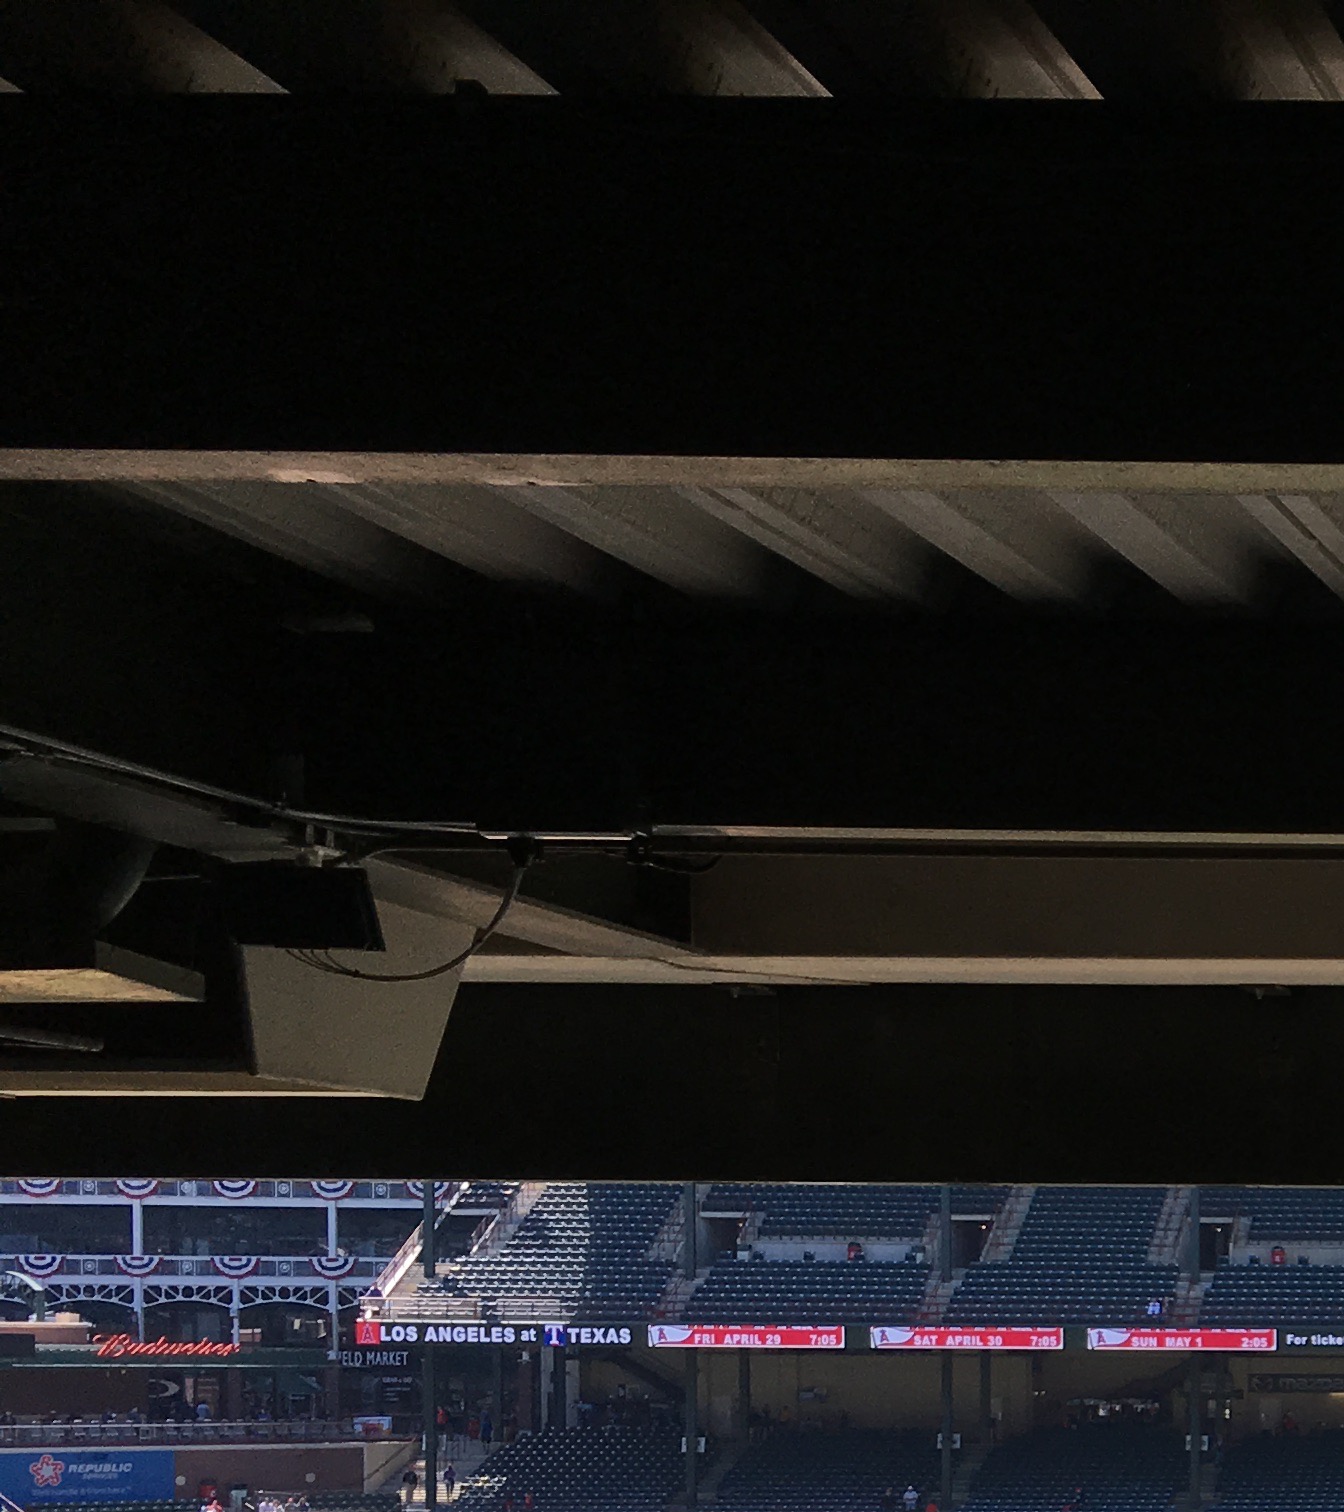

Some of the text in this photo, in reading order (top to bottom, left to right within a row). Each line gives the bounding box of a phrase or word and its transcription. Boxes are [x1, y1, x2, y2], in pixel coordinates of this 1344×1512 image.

[380, 1325, 537, 1343] LOS ANGELES at
[567, 1327, 632, 1344] TEXAS
[694, 1334, 837, 1346] FRI APRIL 29 7:05
[1286, 1334, 1308, 1345] For
[913, 1335, 1057, 1347] SAT APRIL 30 7:05
[1131, 1337, 1268, 1348] SUN MAY 1 2:05
[366, 1351, 409, 1366] MARKET
[68, 1463, 133, 1473] REPUBLIC
